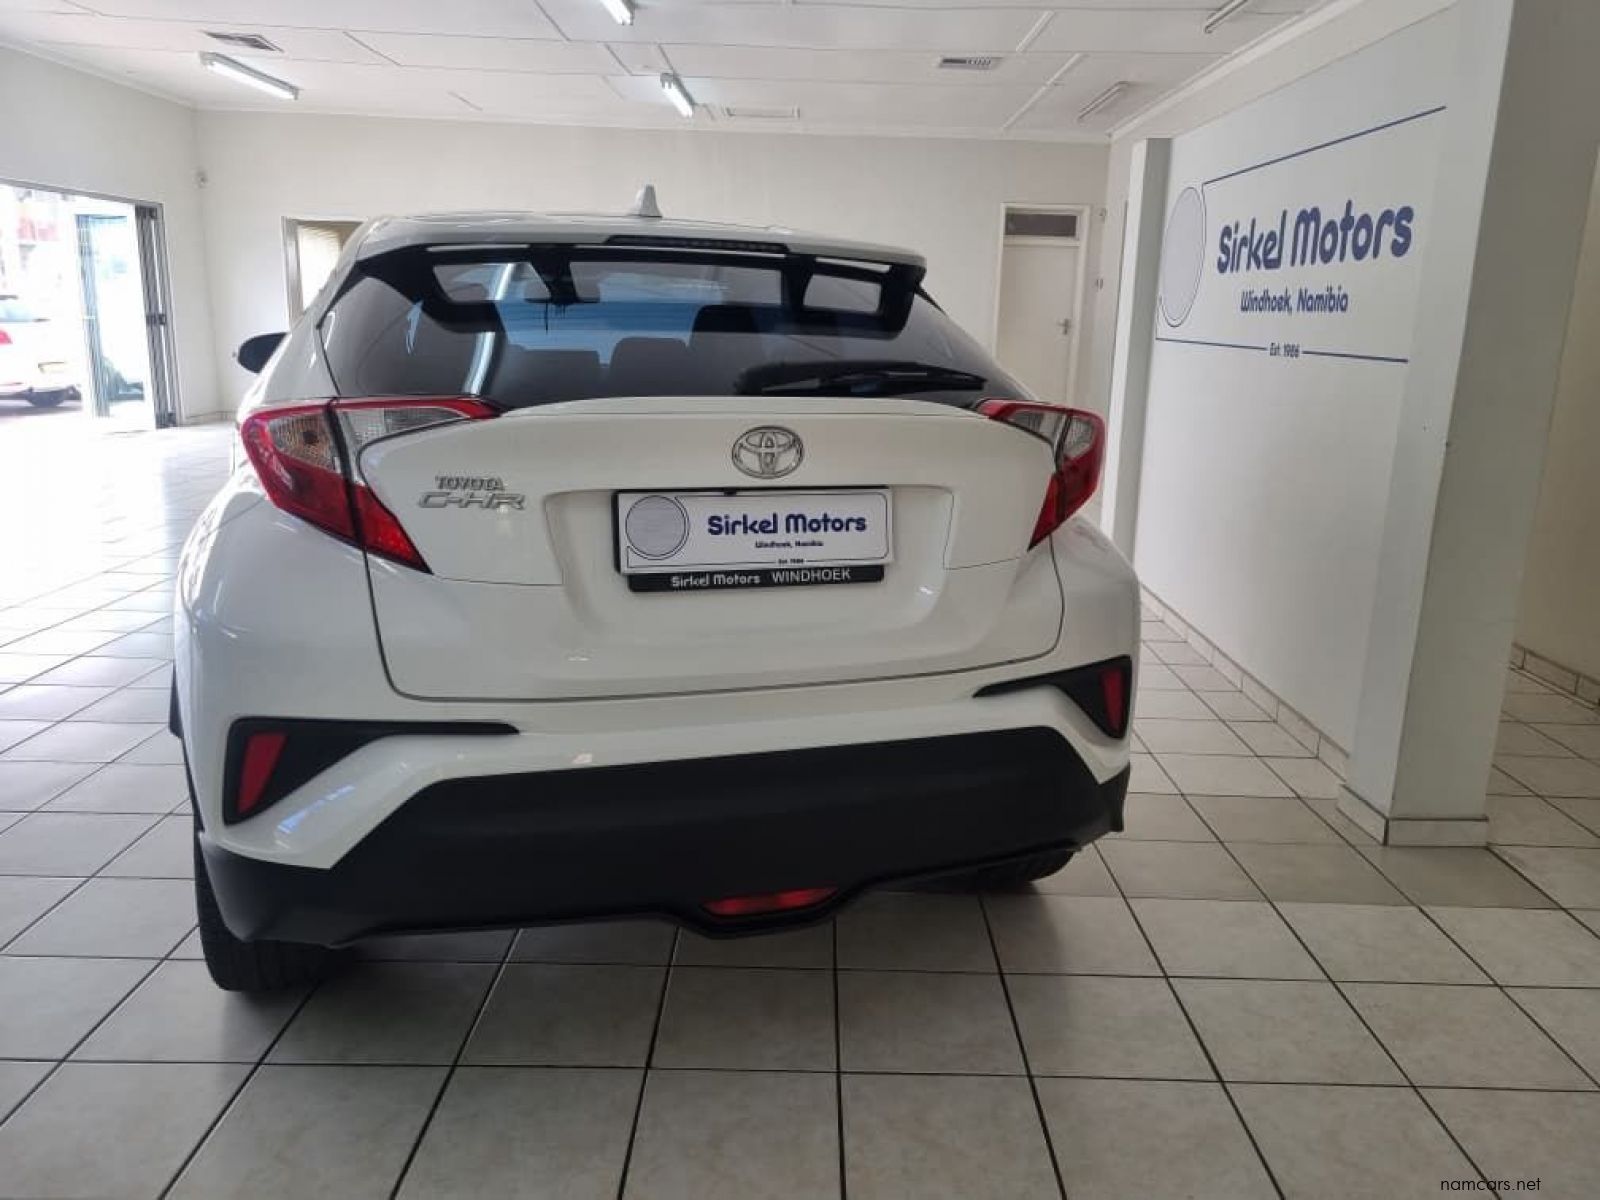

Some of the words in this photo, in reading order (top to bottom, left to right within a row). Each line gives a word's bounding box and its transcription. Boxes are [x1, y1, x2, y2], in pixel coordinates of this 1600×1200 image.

[1217, 208, 1288, 274] Sirkel
[1290, 198, 1415, 268] Motors
[1297, 284, 1349, 313] Namibia
[434, 475, 505, 491] TOYOTA
[418, 491, 526, 510] C-HR
[707, 512, 779, 536] Sirkel
[785, 512, 867, 534] Motors
[670, 573, 710, 588] Sirkel
[713, 572, 761, 586] Motors
[771, 567, 851, 584] WINDHOEK
